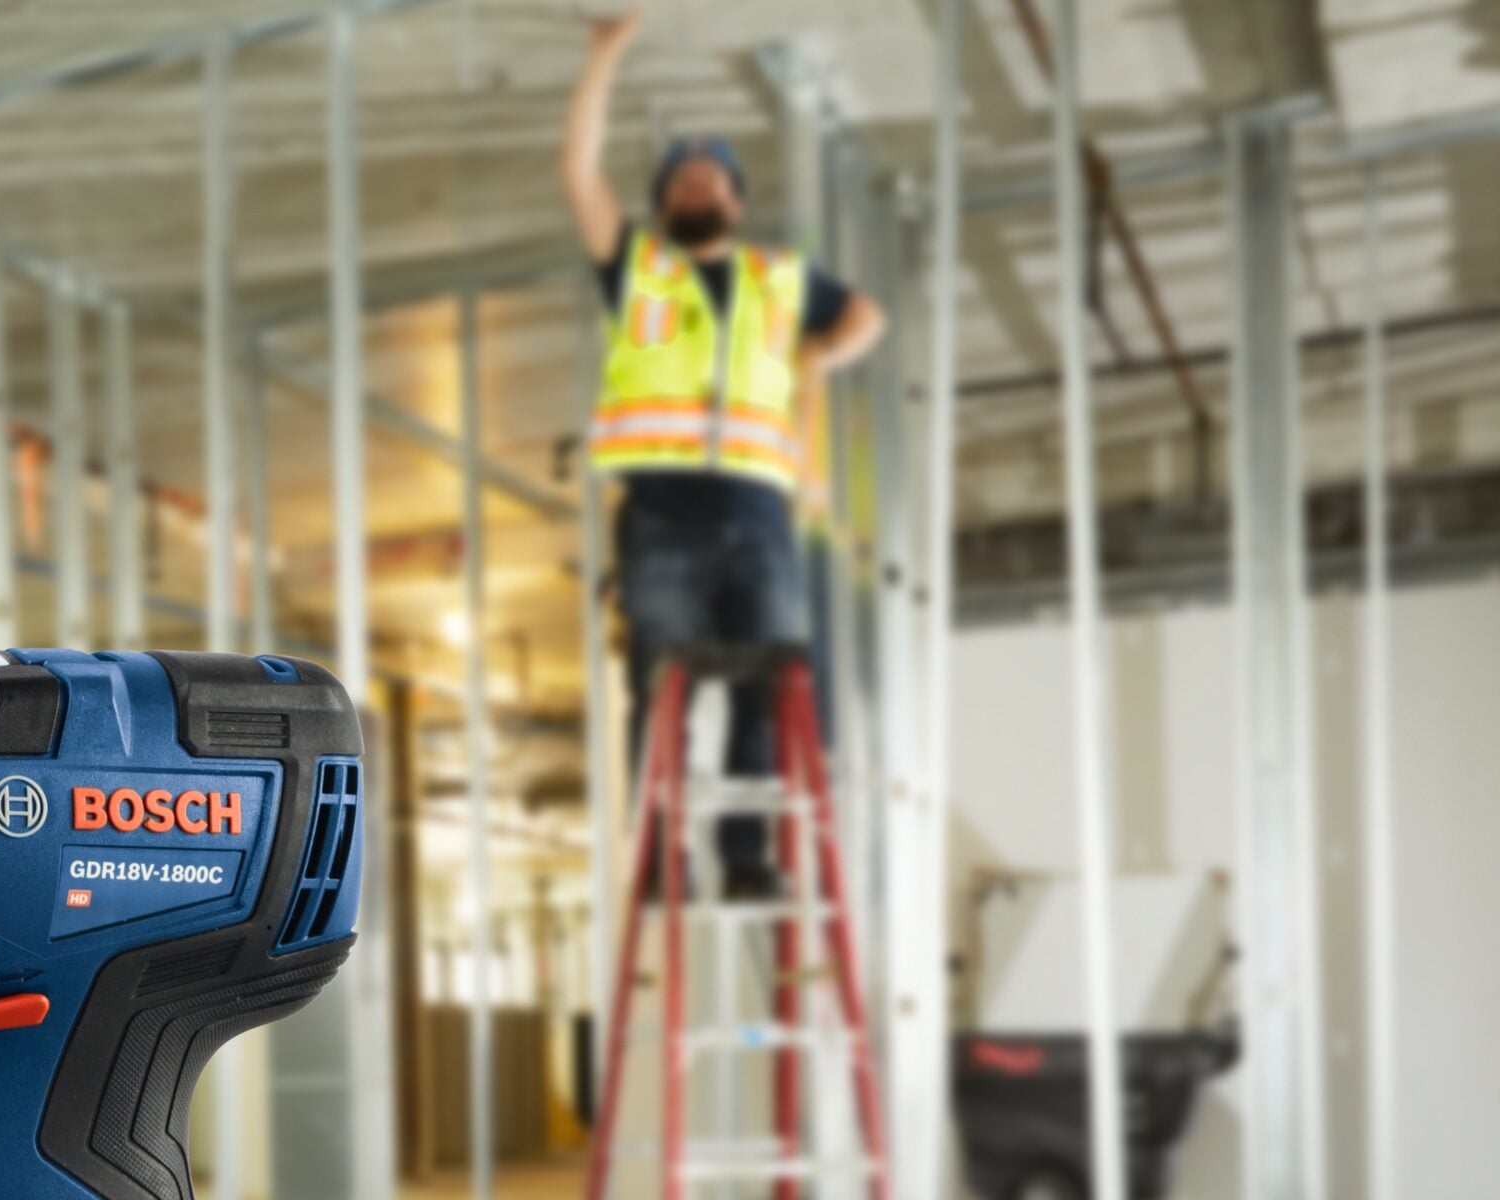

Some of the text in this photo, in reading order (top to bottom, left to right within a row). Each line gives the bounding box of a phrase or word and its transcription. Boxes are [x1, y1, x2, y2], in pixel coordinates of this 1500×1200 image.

[72, 787, 242, 835] BOSCH
[69, 859, 224, 885] GDR18V-1800C
[69, 893, 88, 905] HD
